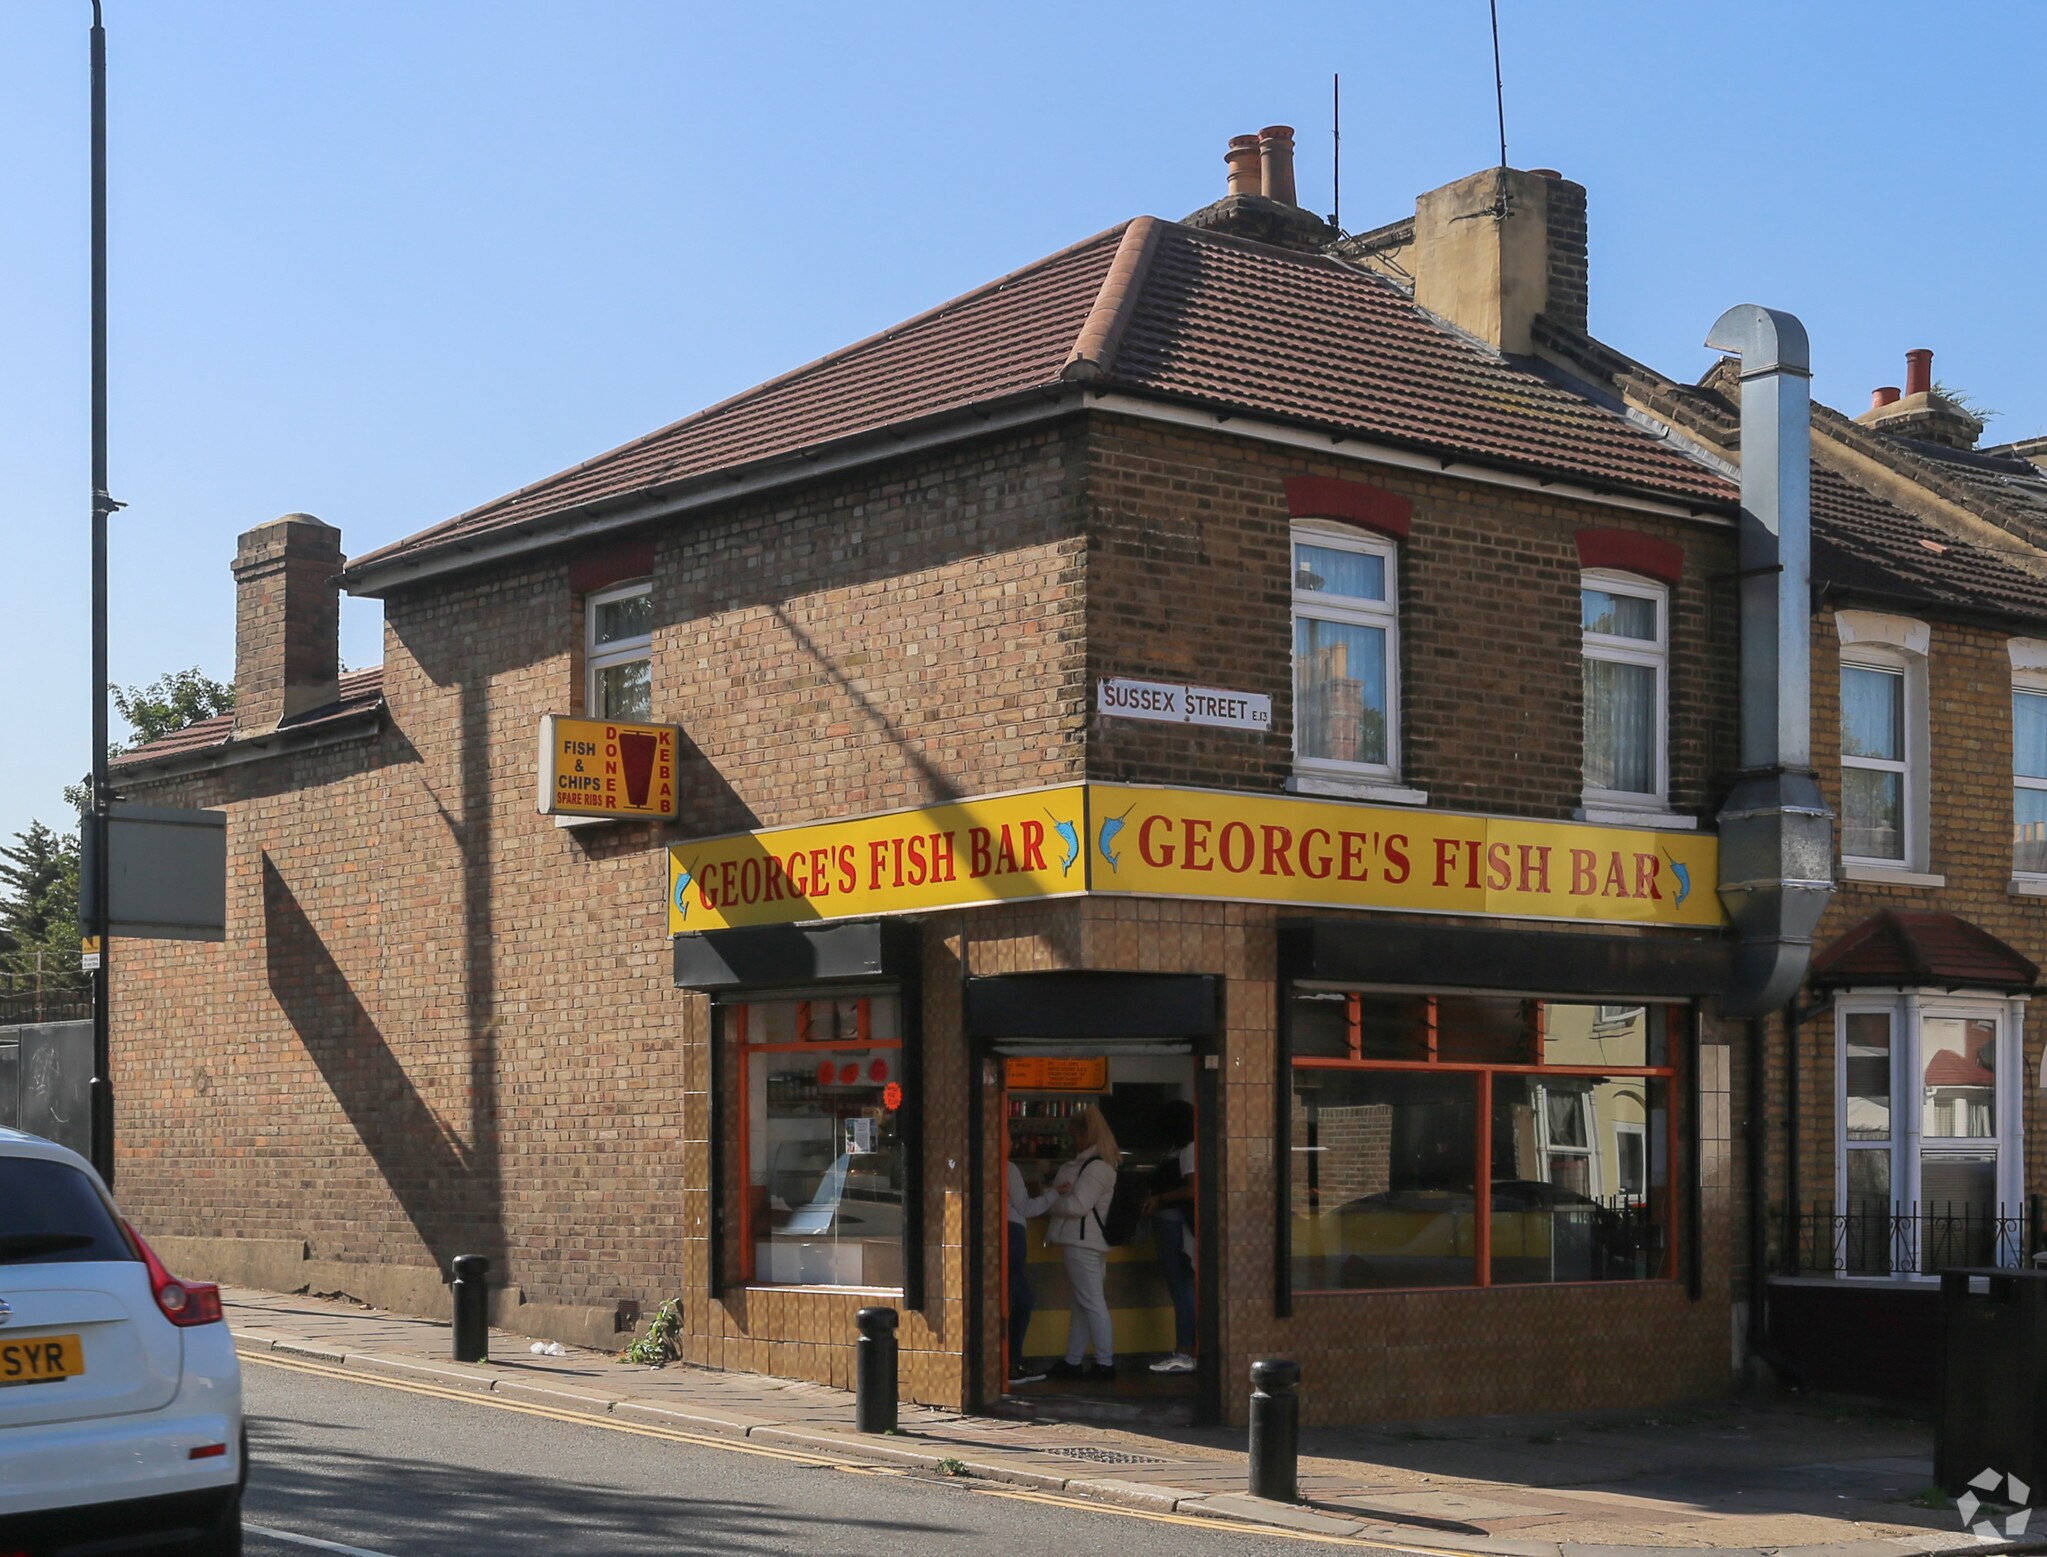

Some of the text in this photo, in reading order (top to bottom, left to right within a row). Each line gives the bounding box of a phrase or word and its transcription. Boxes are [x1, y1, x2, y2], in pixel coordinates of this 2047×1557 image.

[1104, 686, 1175, 713] SUSSEX
[1185, 694, 1248, 720] STREET
[564, 740, 596, 756] FISH
[558, 774, 601, 791] CHIPS
[574, 758, 585, 773] &
[605, 726, 617, 809] DONER
[658, 731, 672, 813] KEBAB
[557, 791, 603, 807] SPARE RIBS
[699, 819, 1048, 911] GEORGE'S FISH BAR
[1137, 813, 1664, 901] GEORGE'S FISH BAR
[2, 1342, 66, 1377] SYR
